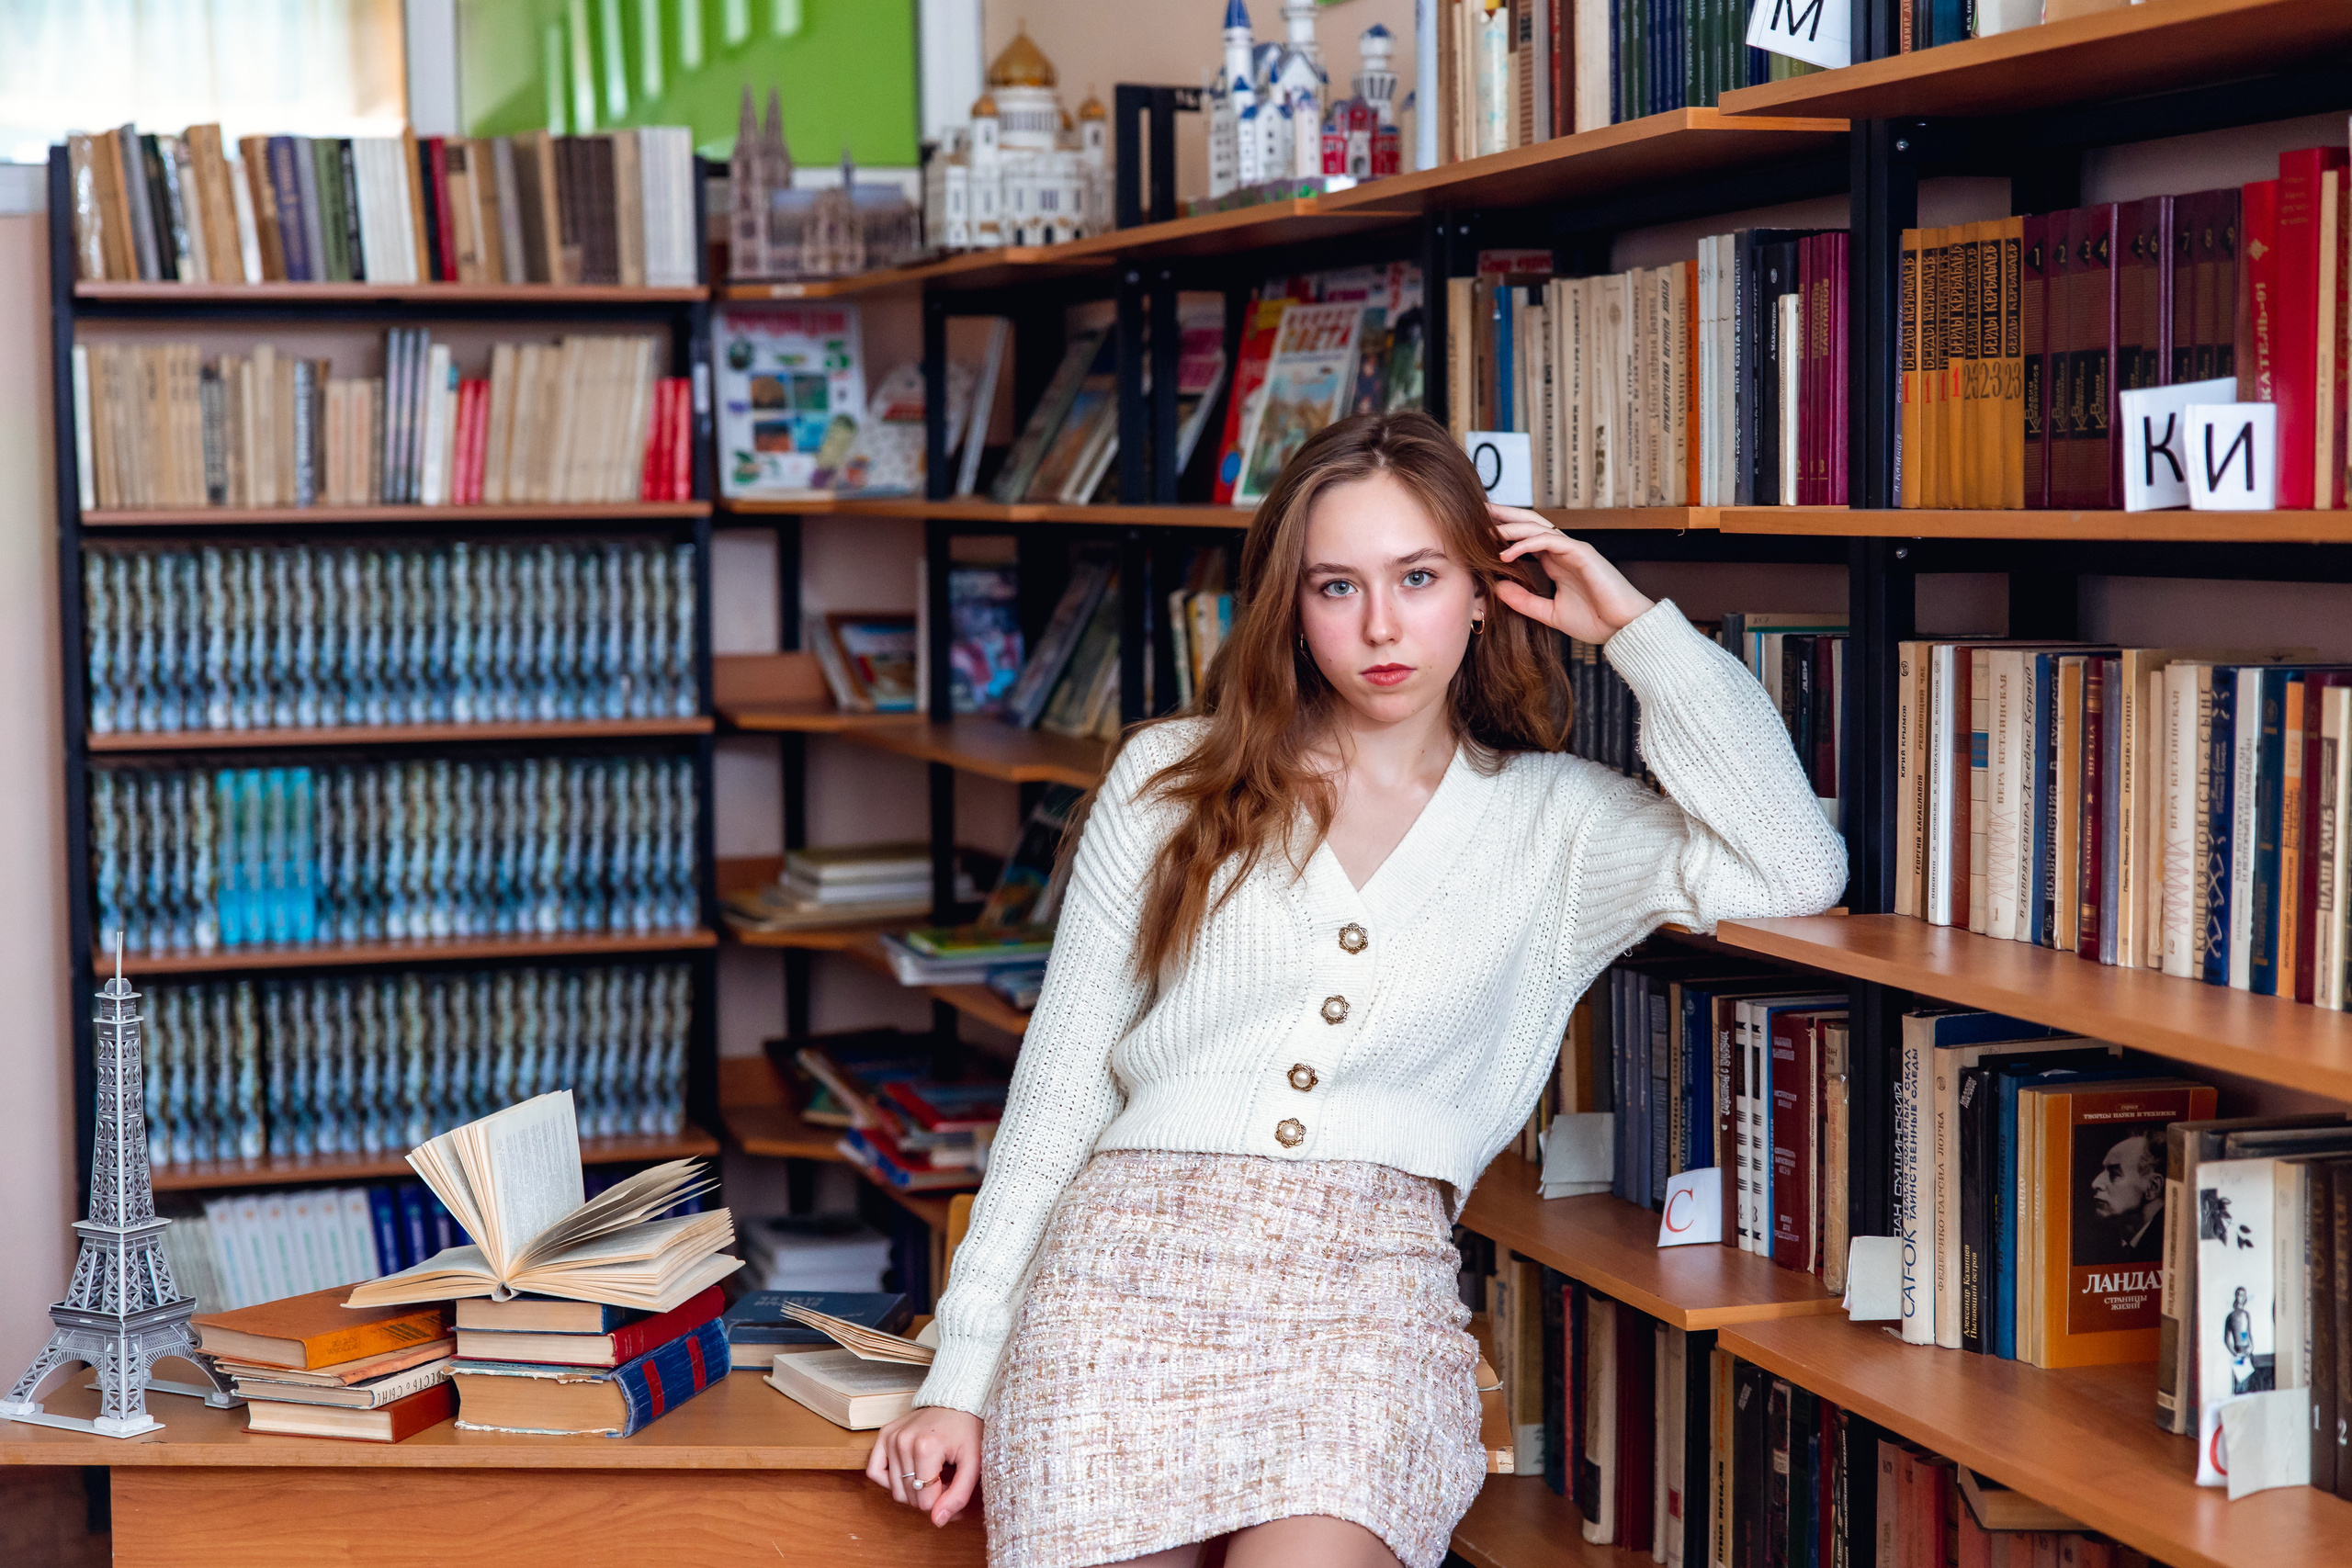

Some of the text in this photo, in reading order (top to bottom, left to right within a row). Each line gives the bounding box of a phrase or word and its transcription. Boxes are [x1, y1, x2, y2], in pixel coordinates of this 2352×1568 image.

[1770, 0, 1825, 42] М
[2032, 247, 2041, 265] 1
[2057, 245, 2066, 264] 2
[2084, 241, 2091, 259] 3
[2098, 239, 2109, 258] 4
[1903, 256, 1917, 369] БЕРДЫ КЕРБАБАЕВ
[1923, 255, 1937, 368] БЕРДЫ КЕРБАБАЕВ
[1938, 254, 1949, 367] БЕРДЫ КЕРБАБАЕВ
[1950, 245, 1964, 354] БЕРДЫ КЕРБАБАЕВ
[1966, 248, 1978, 356] БЕРДЫ КЕРБАБАЕВ
[1983, 244, 1998, 355] БЕРДЫ КЕРБАБАЕВ
[2007, 243, 2018, 354] БЕРДЫ КЕРБАБАЕВ
[2255, 281, 2273, 402] КАТЕЛЬ-91
[1904, 374, 1911, 403] 1
[1925, 374, 1931, 403] 1
[1939, 371, 1947, 401] 1
[1952, 367, 1961, 397] 1
[2143, 412, 2184, 487] К
[2205, 422, 2255, 493] И
[1917, 689, 1926, 750] РЕШАЮЩИЙ
[1996, 675, 2007, 805] ВЕРА КЕТЛИНСКАЯ
[2199, 688, 2212, 743] СЫНЕ
[2022, 729, 2031, 798] Джеймс
[2086, 725, 2096, 777] ЗВЕЗДА
[2169, 691, 2180, 830] ВЕРА КЕТЛИНСКАЯ
[2198, 768, 2211, 858] ПОВЕСТЬ
[2020, 855, 2029, 906] ДЕБРЯХ
[2320, 862, 2333, 908] НАШ
[2195, 872, 2207, 952] КОШЕВАЯ
[1889, 1081, 1902, 1236] ДАН СУШИНСКИЙ
[1909, 1048, 1918, 1221] ТАИНСТВЕННЫЕ СЛЕДЫ
[1666, 1188, 1694, 1233] С
[1970, 1285, 1978, 1339] Пылающий
[2104, 1295, 2148, 1304] СТРАНИЦЫ
[2111, 1303, 2140, 1311] ЖИЗНИ
[377, 1385, 402, 1406] СЫНЕ
[2337, 1419, 2347, 1447] 2
